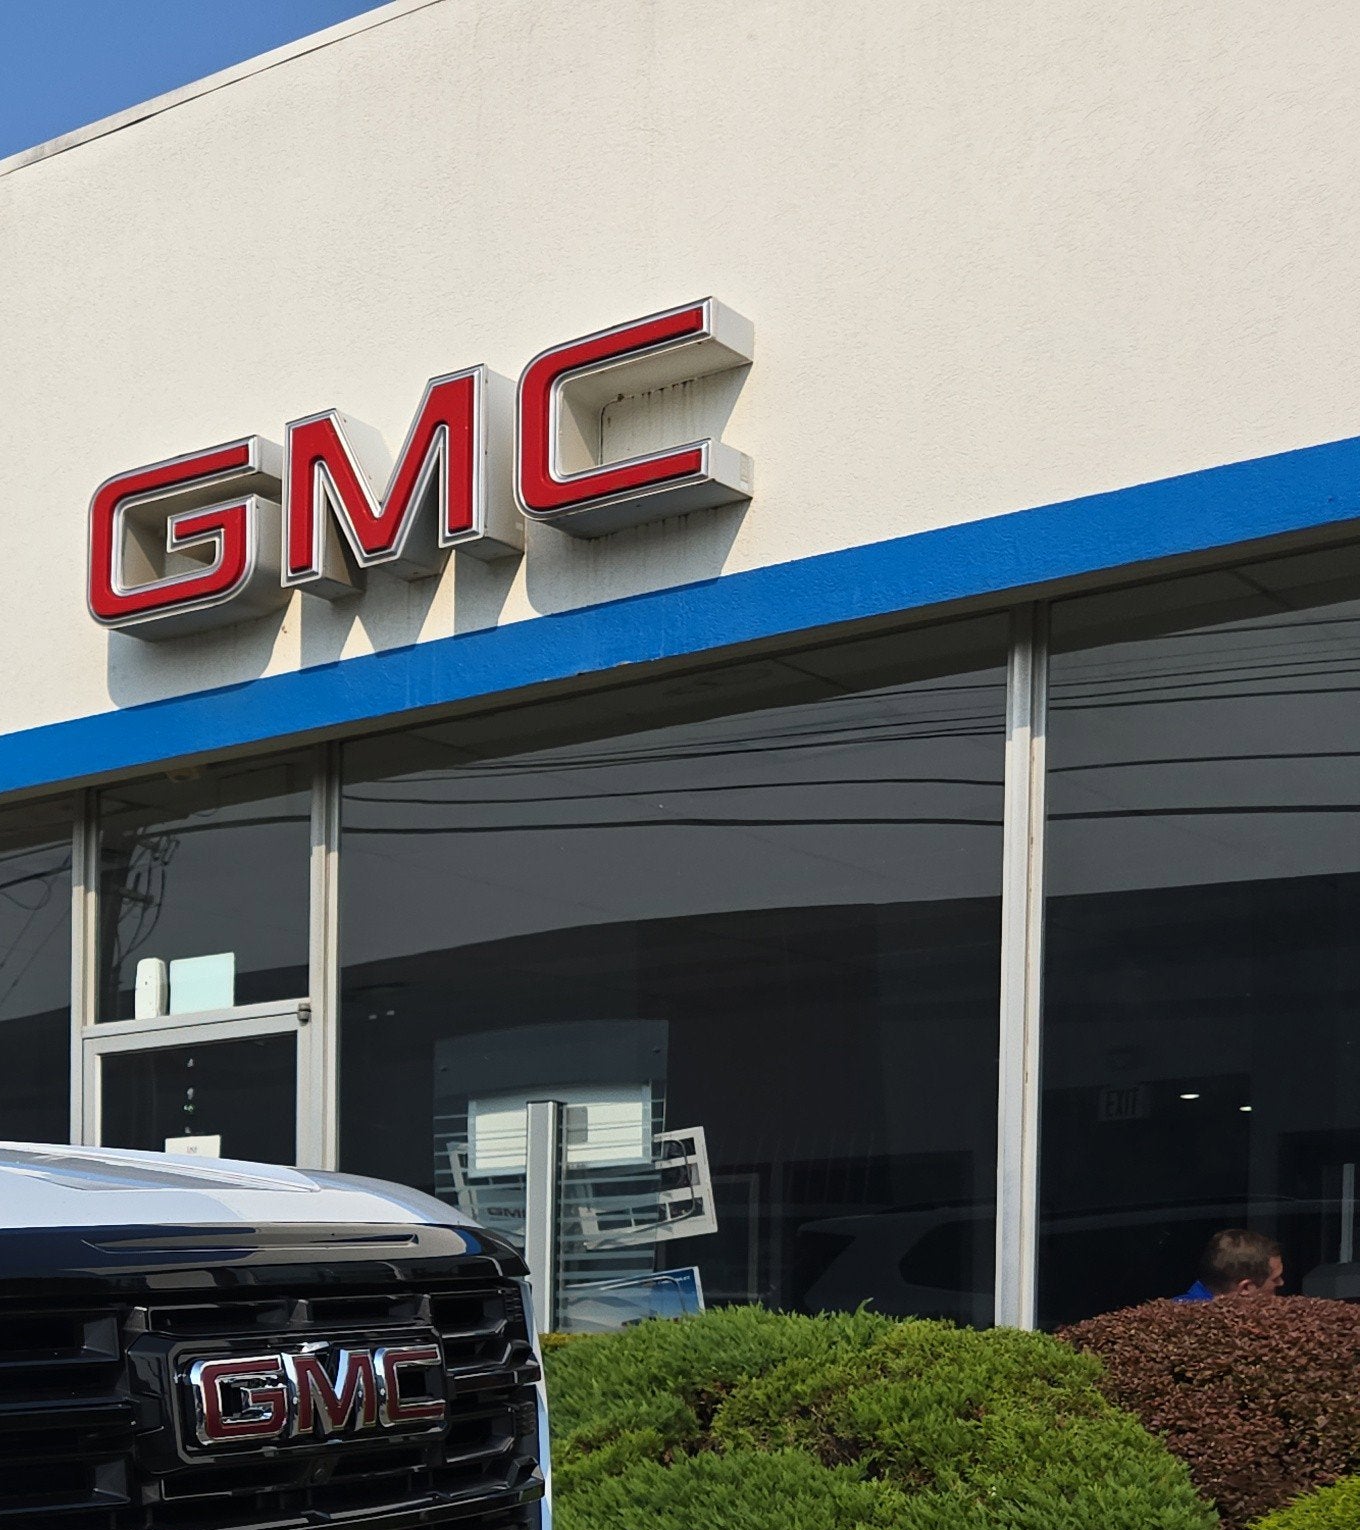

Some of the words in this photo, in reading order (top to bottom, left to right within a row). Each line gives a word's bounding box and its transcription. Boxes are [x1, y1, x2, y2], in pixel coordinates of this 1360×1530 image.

[87, 296, 736, 632] GMC
[1106, 1087, 1139, 1117] EXIT
[487, 1207, 527, 1219] GM
[189, 1343, 447, 1446] GMC
